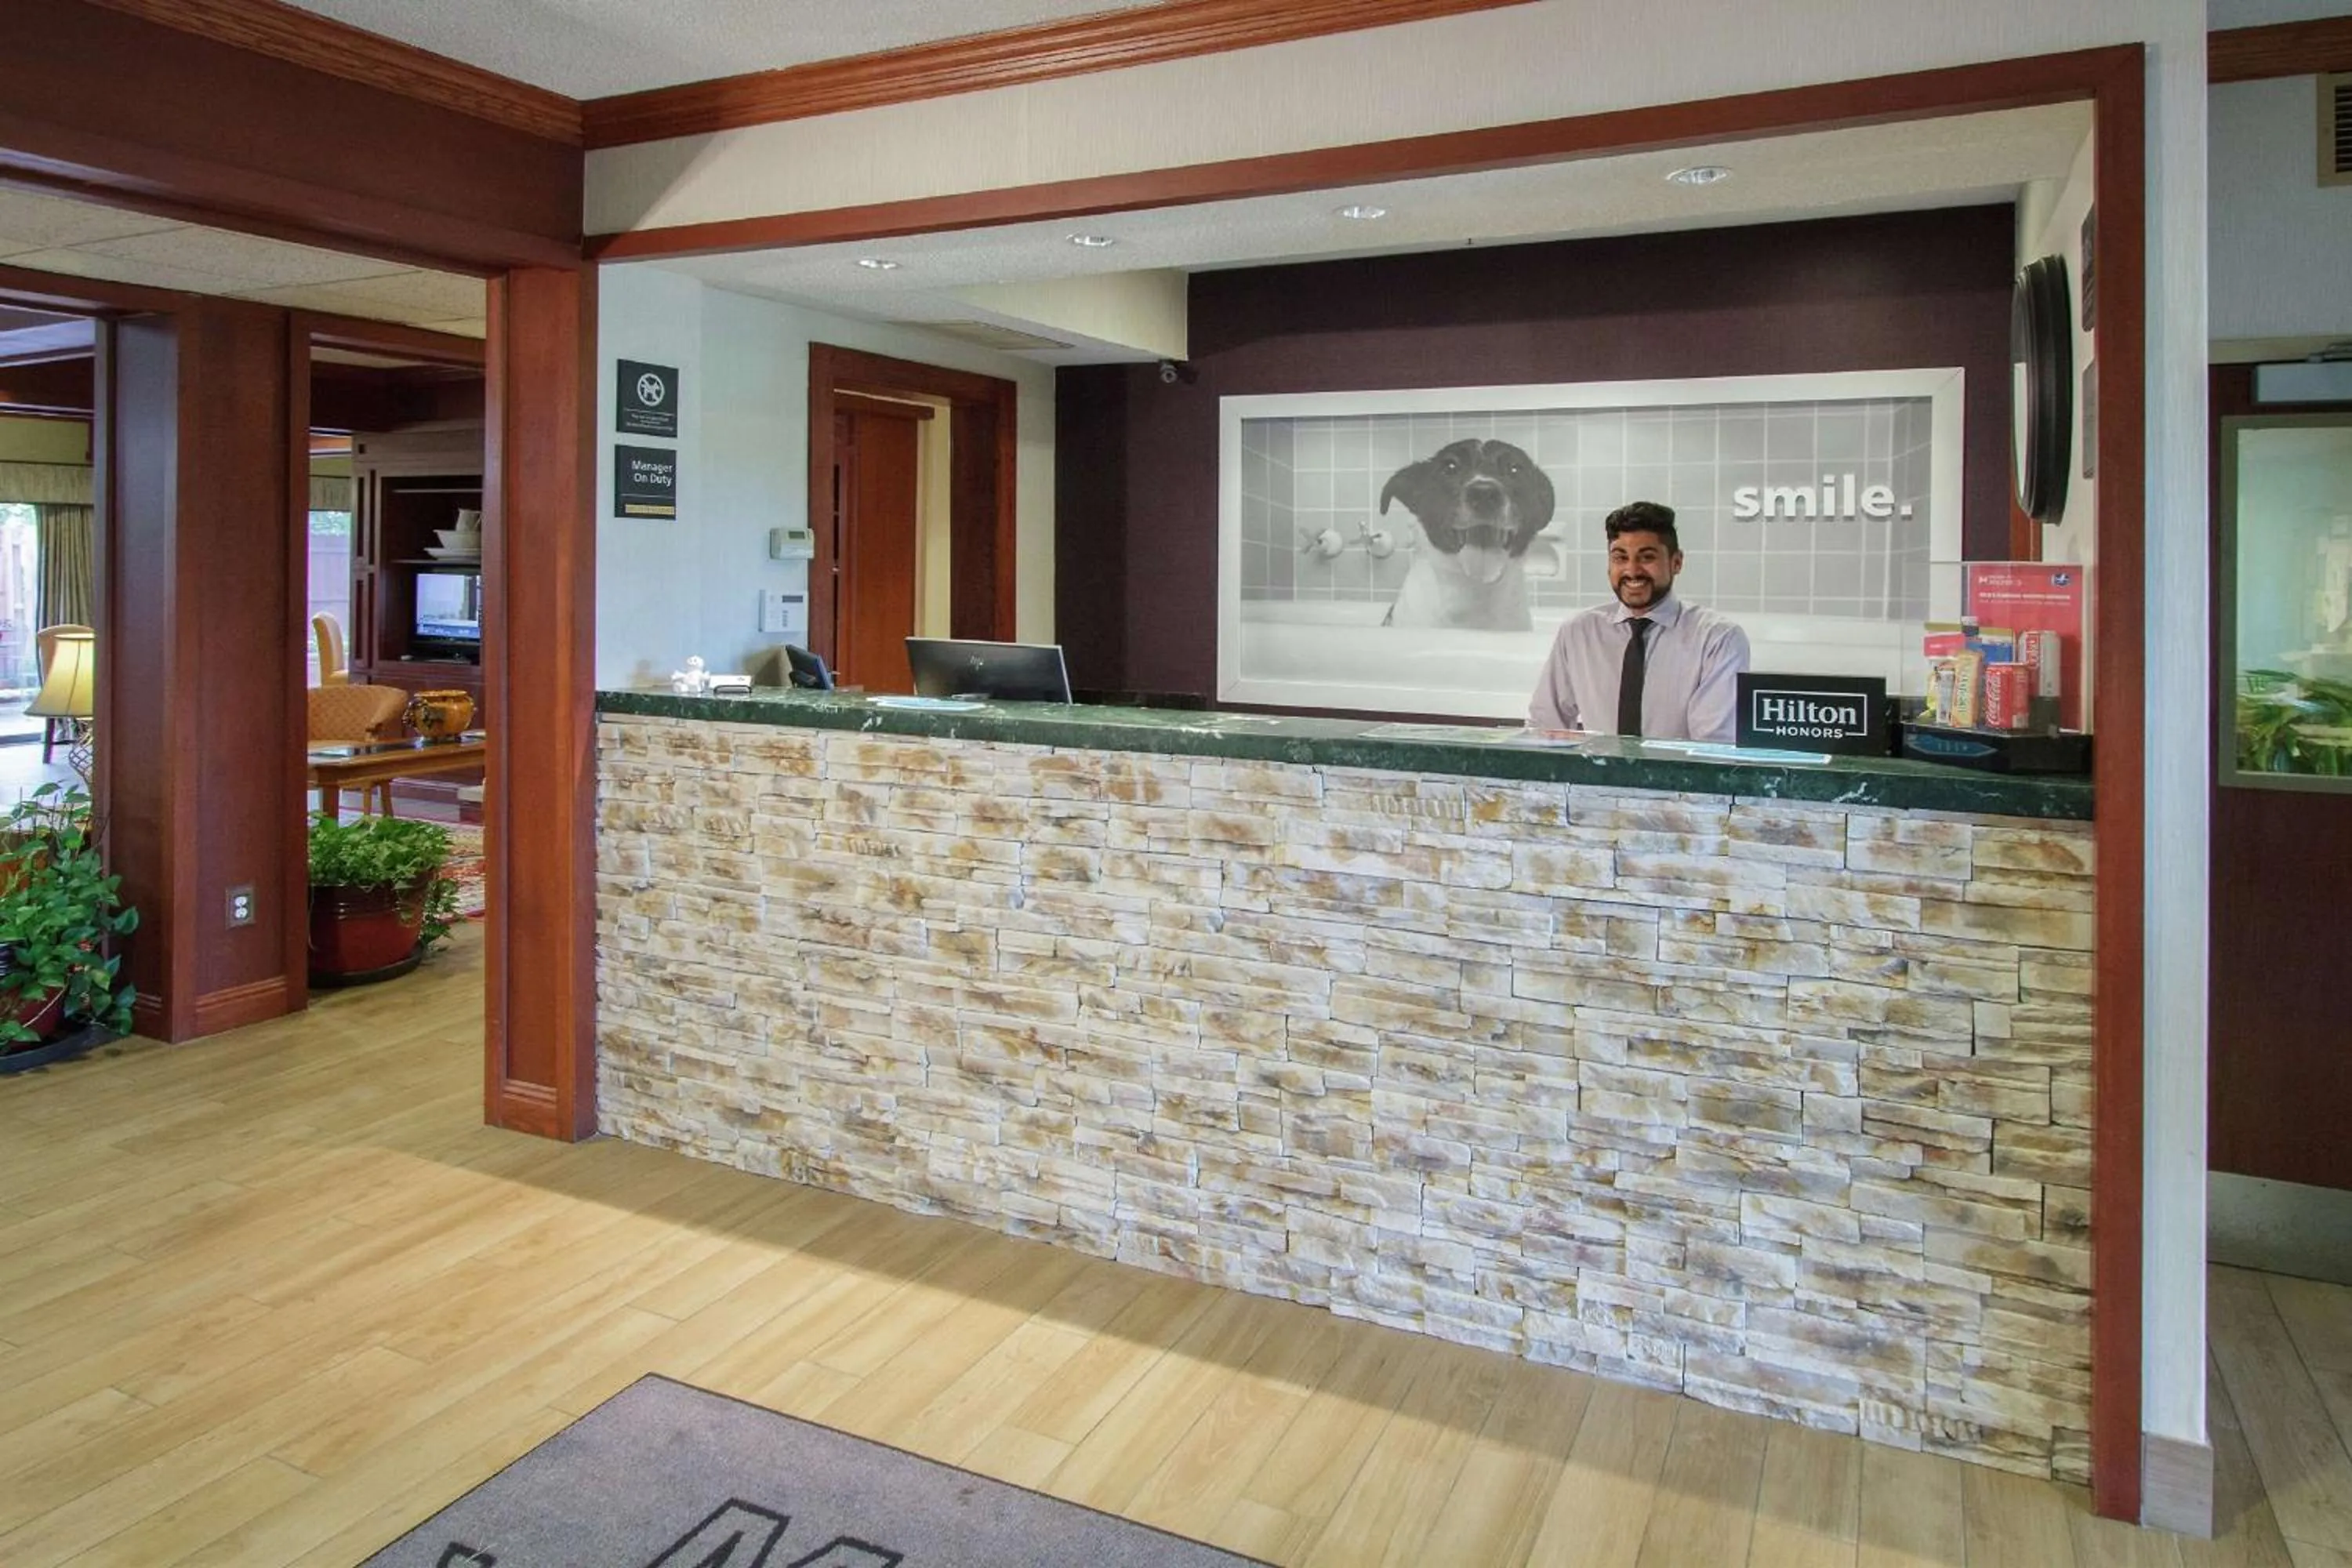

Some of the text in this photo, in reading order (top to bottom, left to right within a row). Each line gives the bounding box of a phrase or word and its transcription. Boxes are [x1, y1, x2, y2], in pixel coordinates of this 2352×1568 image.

[631, 460, 673, 474] Manager
[633, 473, 672, 487] On Duty
[1733, 474, 1913, 518] smile.
[1762, 698, 1857, 725] Hilton
[1776, 725, 1843, 739] HONORS
